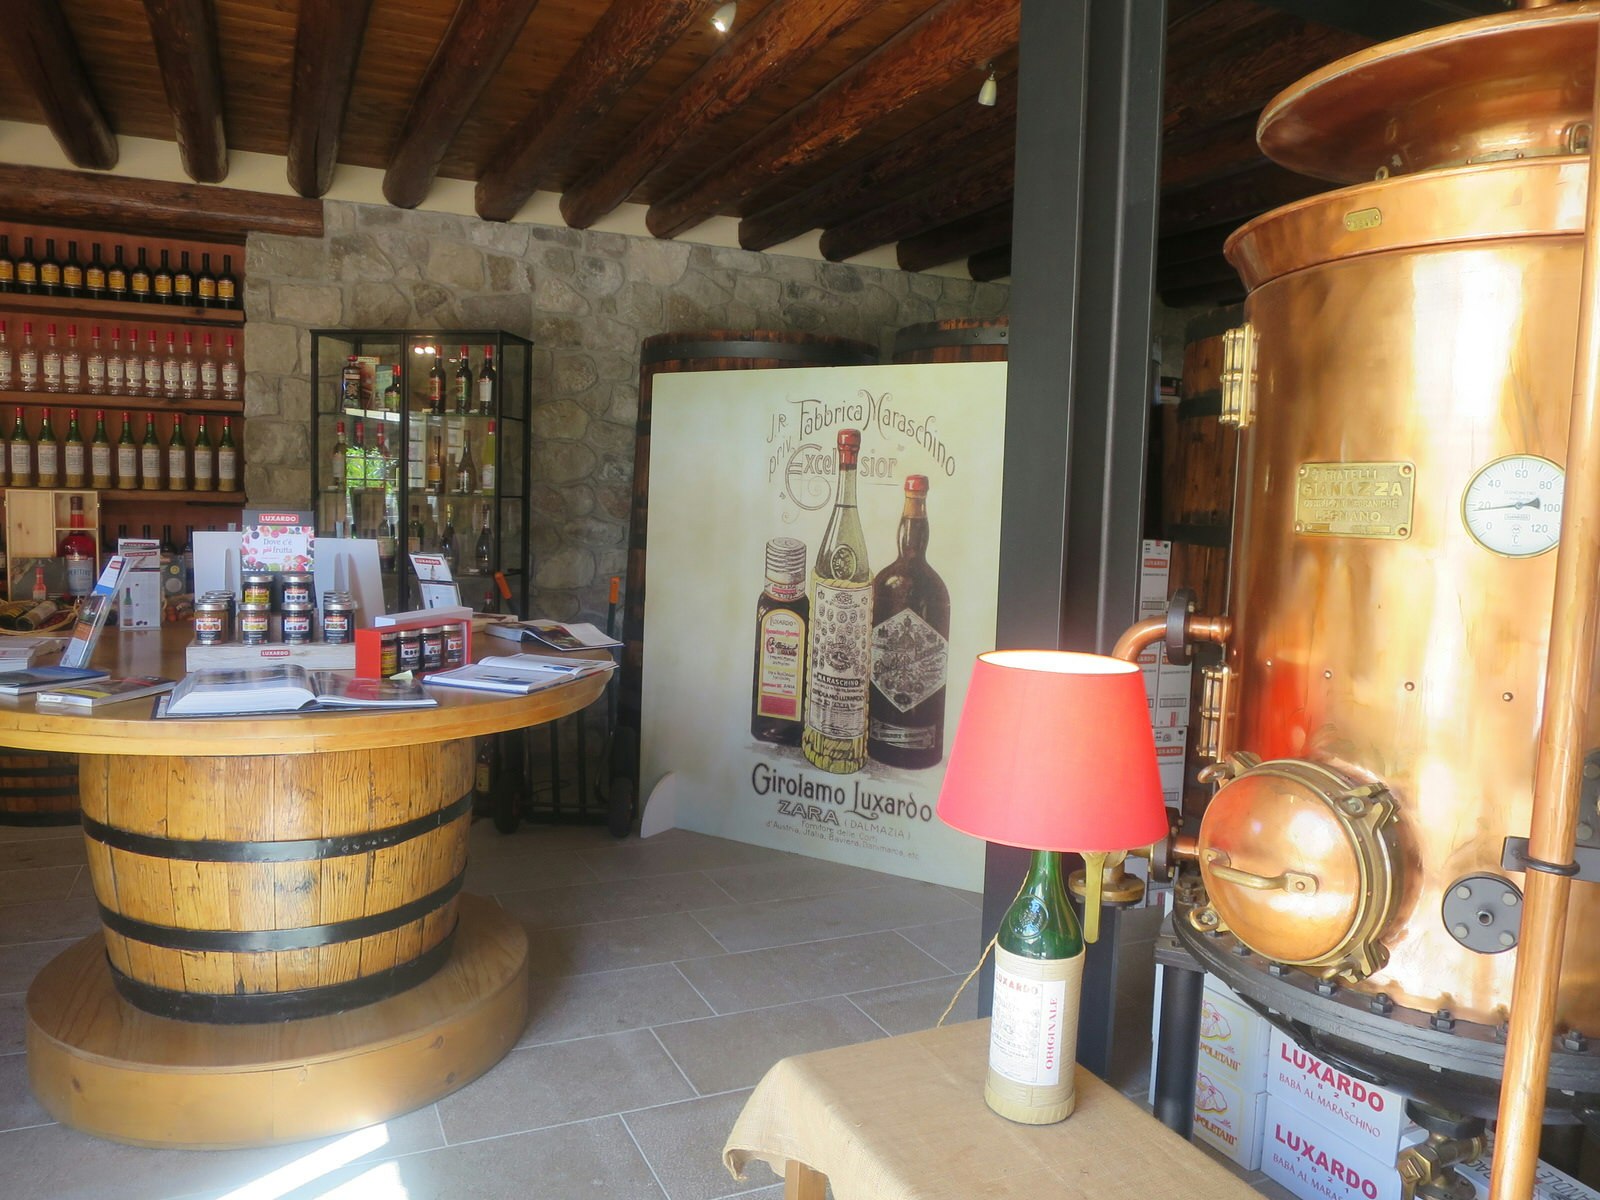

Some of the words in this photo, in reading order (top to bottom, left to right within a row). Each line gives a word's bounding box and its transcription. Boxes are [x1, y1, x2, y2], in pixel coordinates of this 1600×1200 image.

[786, 399, 863, 442] Fabbrica
[858, 389, 955, 476] Maraschino
[1515, 469, 1528, 478] 60
[1488, 479, 1501, 488] 40
[1538, 480, 1552, 490] 80
[1479, 500, 1491, 509] 20
[1543, 503, 1560, 513] 100
[1315, 510, 1381, 522] LEGNANO
[1486, 521, 1492, 530] 0
[1531, 523, 1548, 533] 120
[272, 546, 293, 554] frutta
[752, 763, 845, 805] Girolamo
[843, 781, 932, 822] Luxardo
[778, 800, 839, 826] ZARA
[837, 828, 855, 838] delle
[995, 971, 1039, 996] LUXARDO
[1045, 997, 1057, 1071] ORIGINALE
[1281, 1042, 1384, 1112] LUXARDO
[1304, 1088, 1315, 1101] AL
[1317, 1096, 1381, 1138] MARASCHINO
[1275, 1123, 1378, 1200] LUXARDO
[1297, 1170, 1309, 1183] AL
